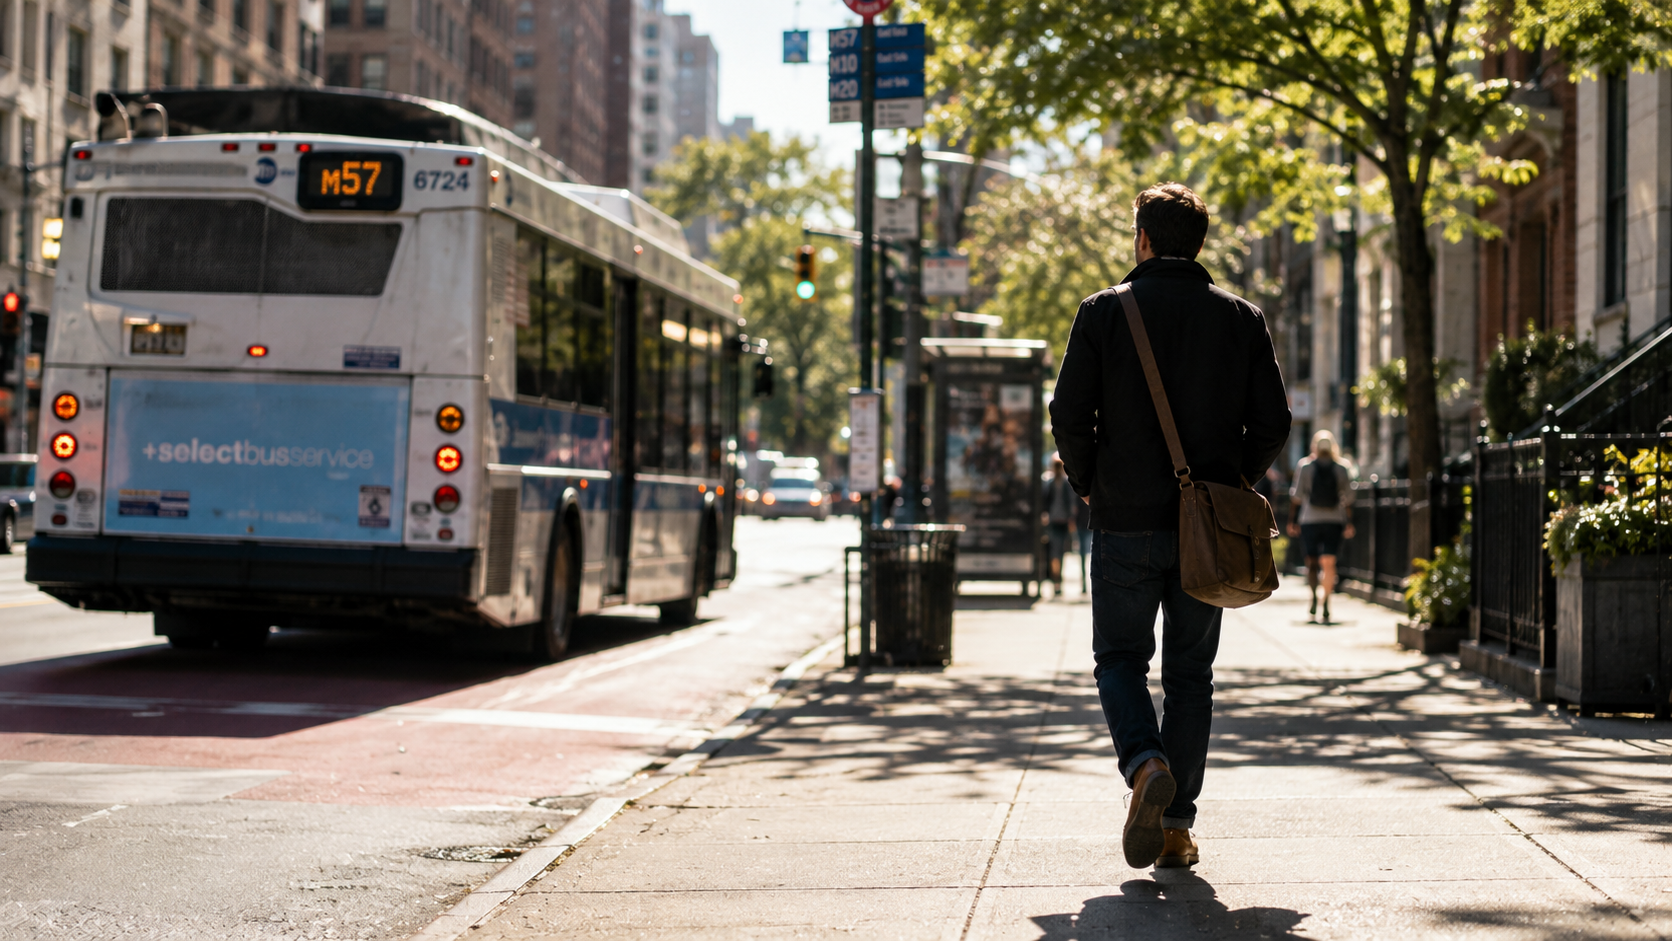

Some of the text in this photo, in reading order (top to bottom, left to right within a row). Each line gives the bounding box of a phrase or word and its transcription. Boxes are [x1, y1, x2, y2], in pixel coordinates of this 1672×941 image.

[830, 28, 858, 49] M57
[830, 54, 858, 75] M10
[830, 79, 858, 99] M20
[321, 160, 382, 196] M57
[414, 170, 470, 191] 6724
